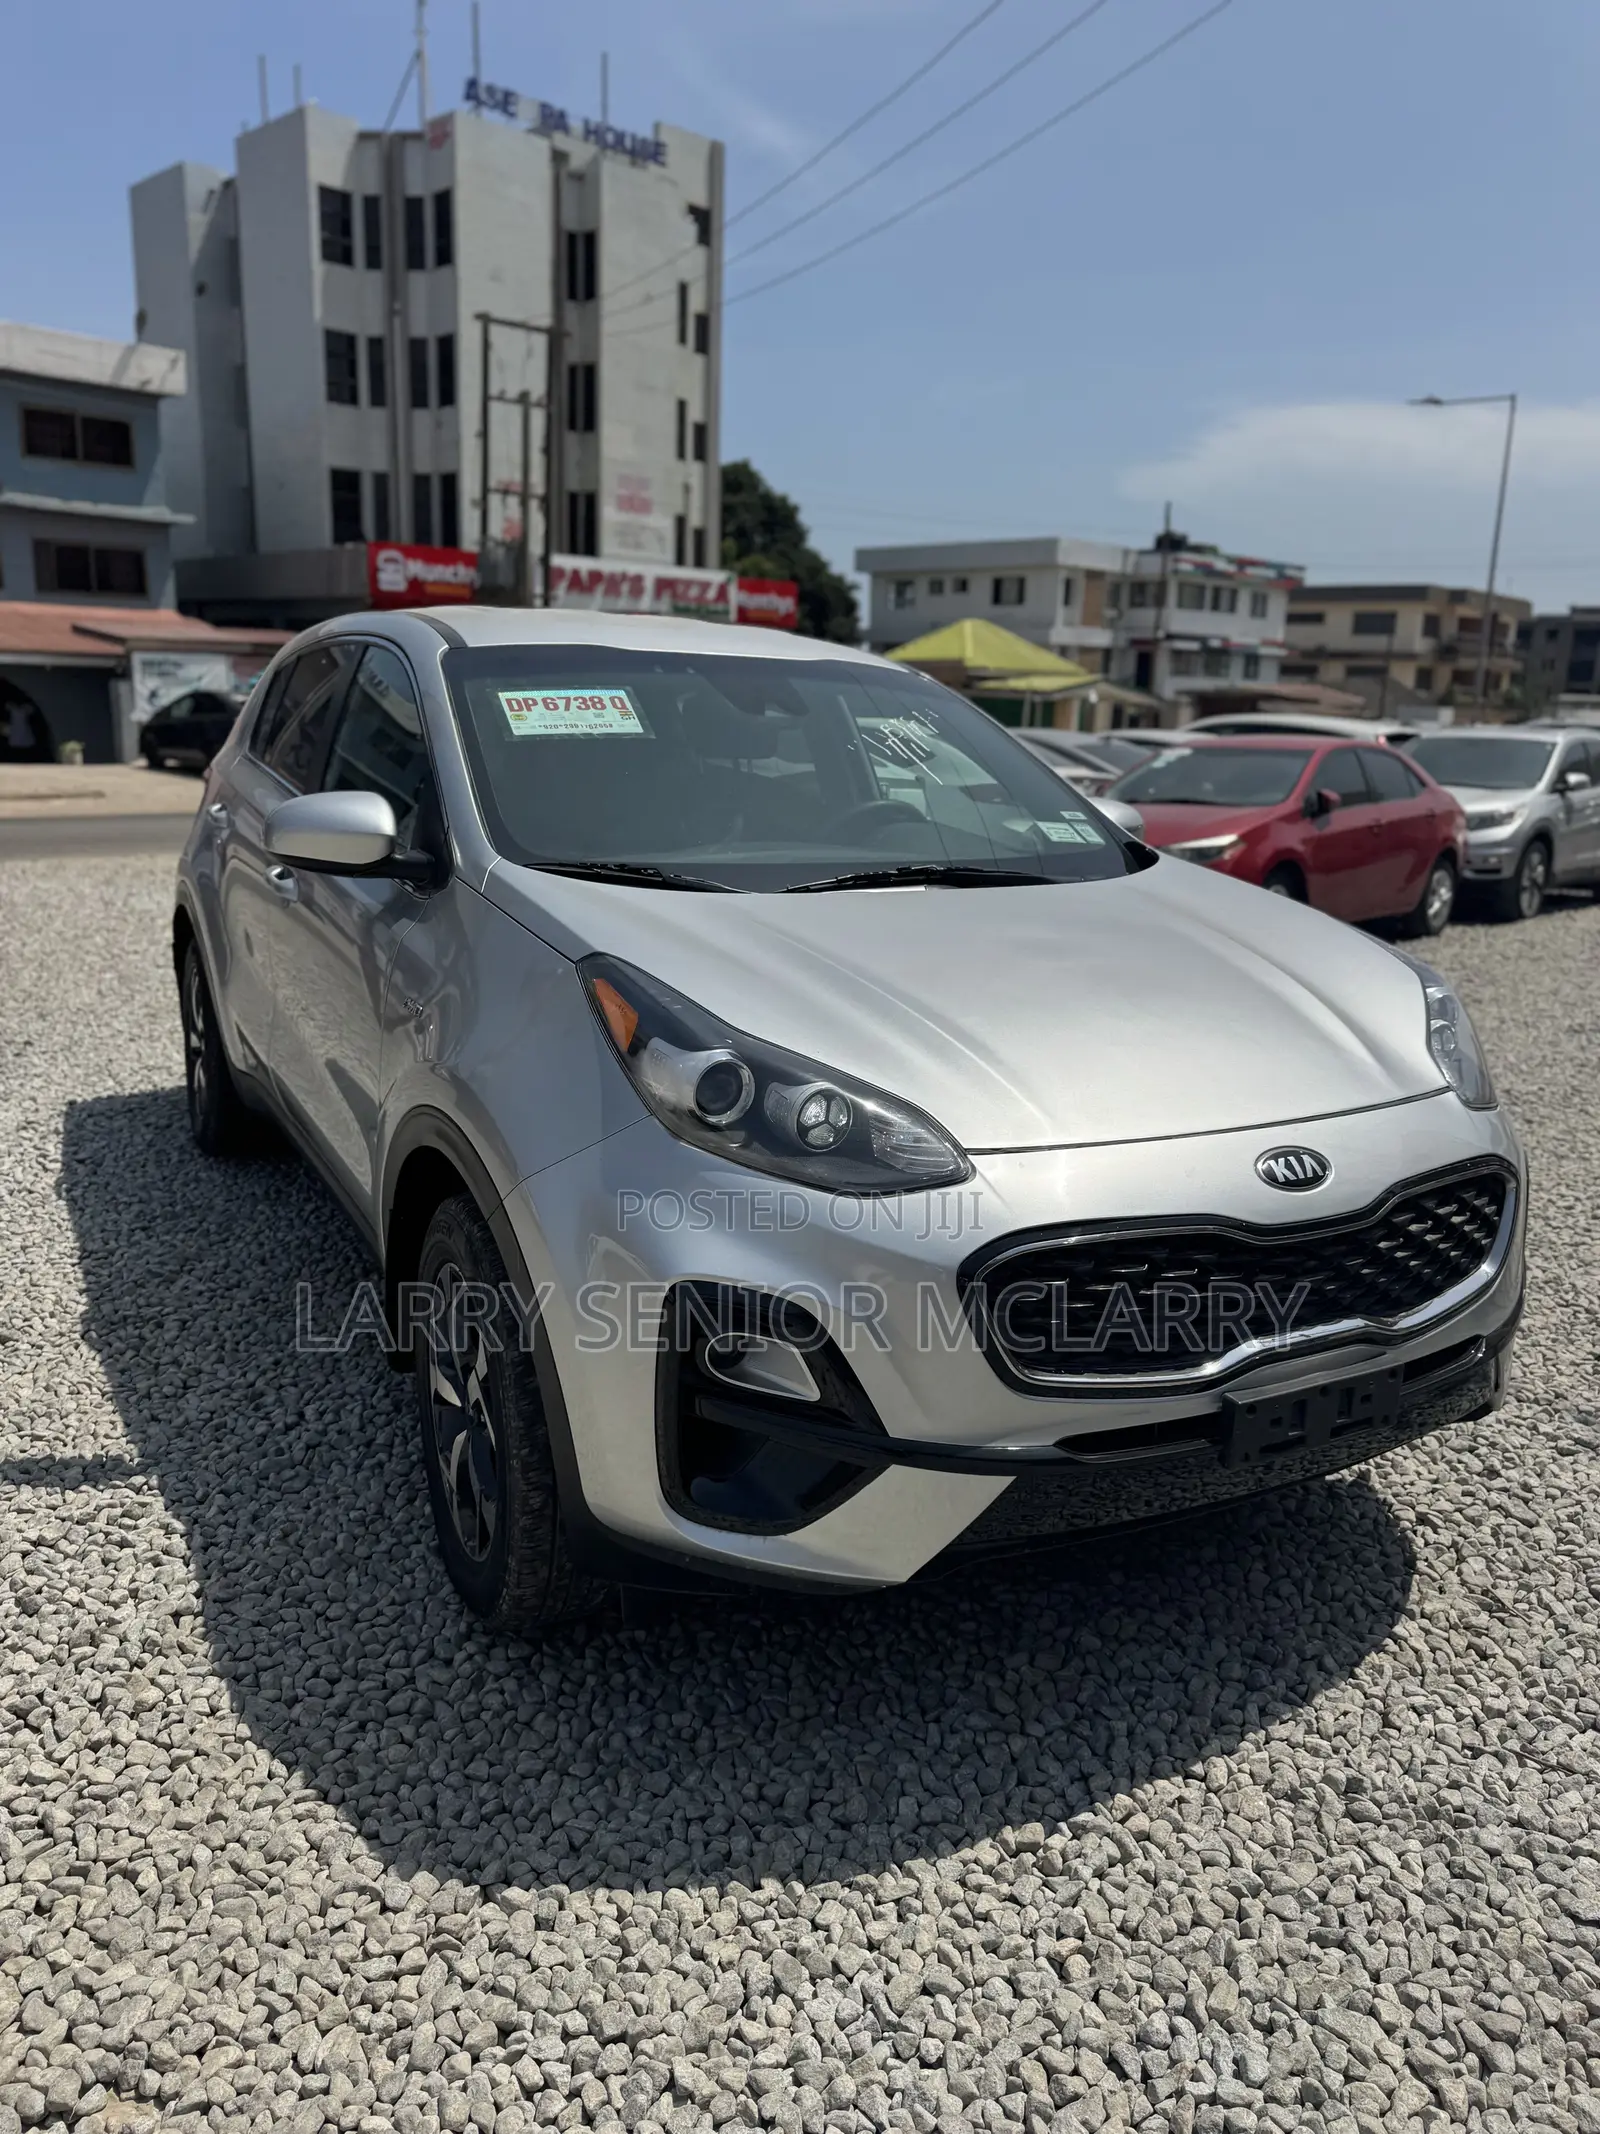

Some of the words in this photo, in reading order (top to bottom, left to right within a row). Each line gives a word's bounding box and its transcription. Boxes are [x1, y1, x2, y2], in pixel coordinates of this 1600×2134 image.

[464, 77, 518, 118] ASE
[539, 101, 570, 135] PA
[582, 117, 668, 167] HOUSE
[654, 576, 730, 605] PIZZA
[505, 698, 538, 712] DP
[541, 696, 607, 712] 6738
[609, 696, 629, 711] Q
[1267, 1154, 1324, 1183] KIA
